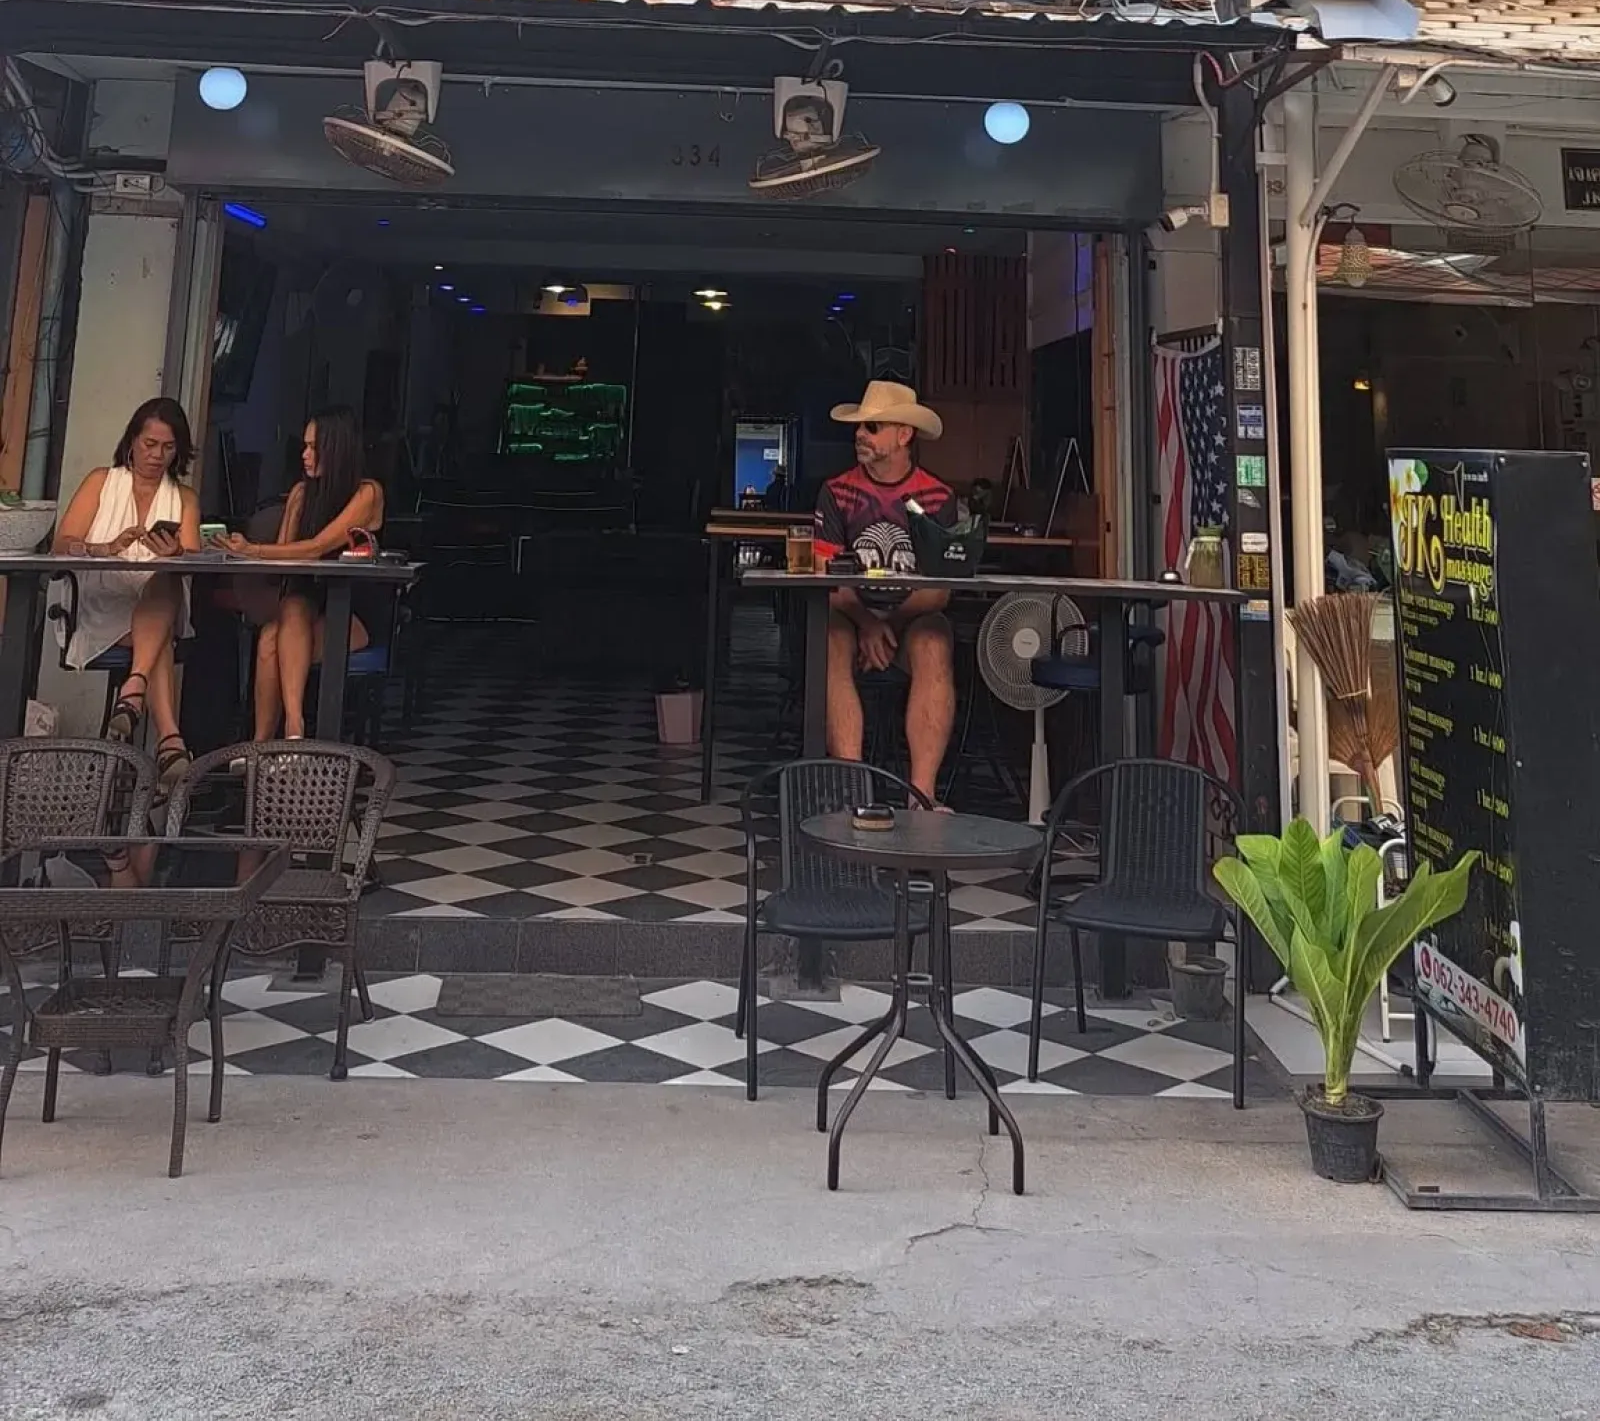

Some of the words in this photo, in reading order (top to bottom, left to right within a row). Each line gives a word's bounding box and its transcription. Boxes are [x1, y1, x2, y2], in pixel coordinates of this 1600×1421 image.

[1440, 494, 1493, 556] Health
[1446, 558, 1494, 601] massage
[1432, 956, 1516, 1044] 062-343-4740
